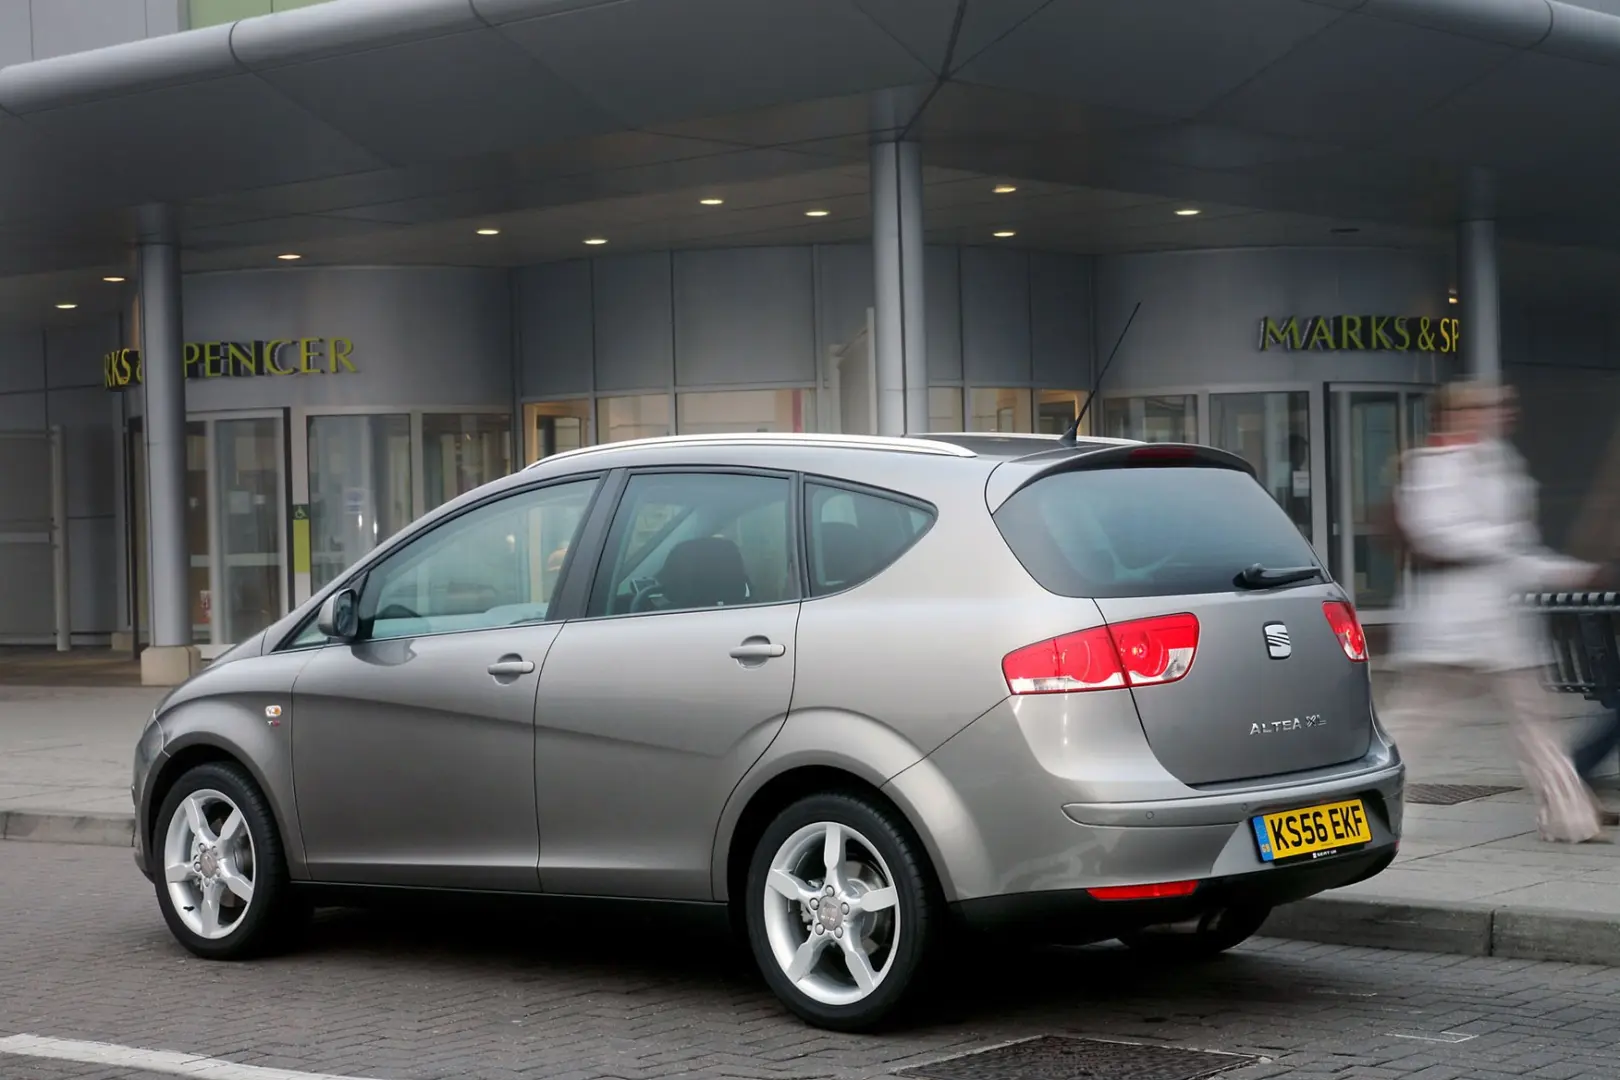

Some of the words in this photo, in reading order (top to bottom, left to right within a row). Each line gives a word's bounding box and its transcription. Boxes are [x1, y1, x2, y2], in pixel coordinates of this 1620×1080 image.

[1260, 314, 1410, 351] MARKS
[1417, 316, 1435, 351] &
[1249, 717, 1302, 735] ALTEA
[1270, 811, 1328, 851] KS56
[1328, 805, 1362, 840] EKF
